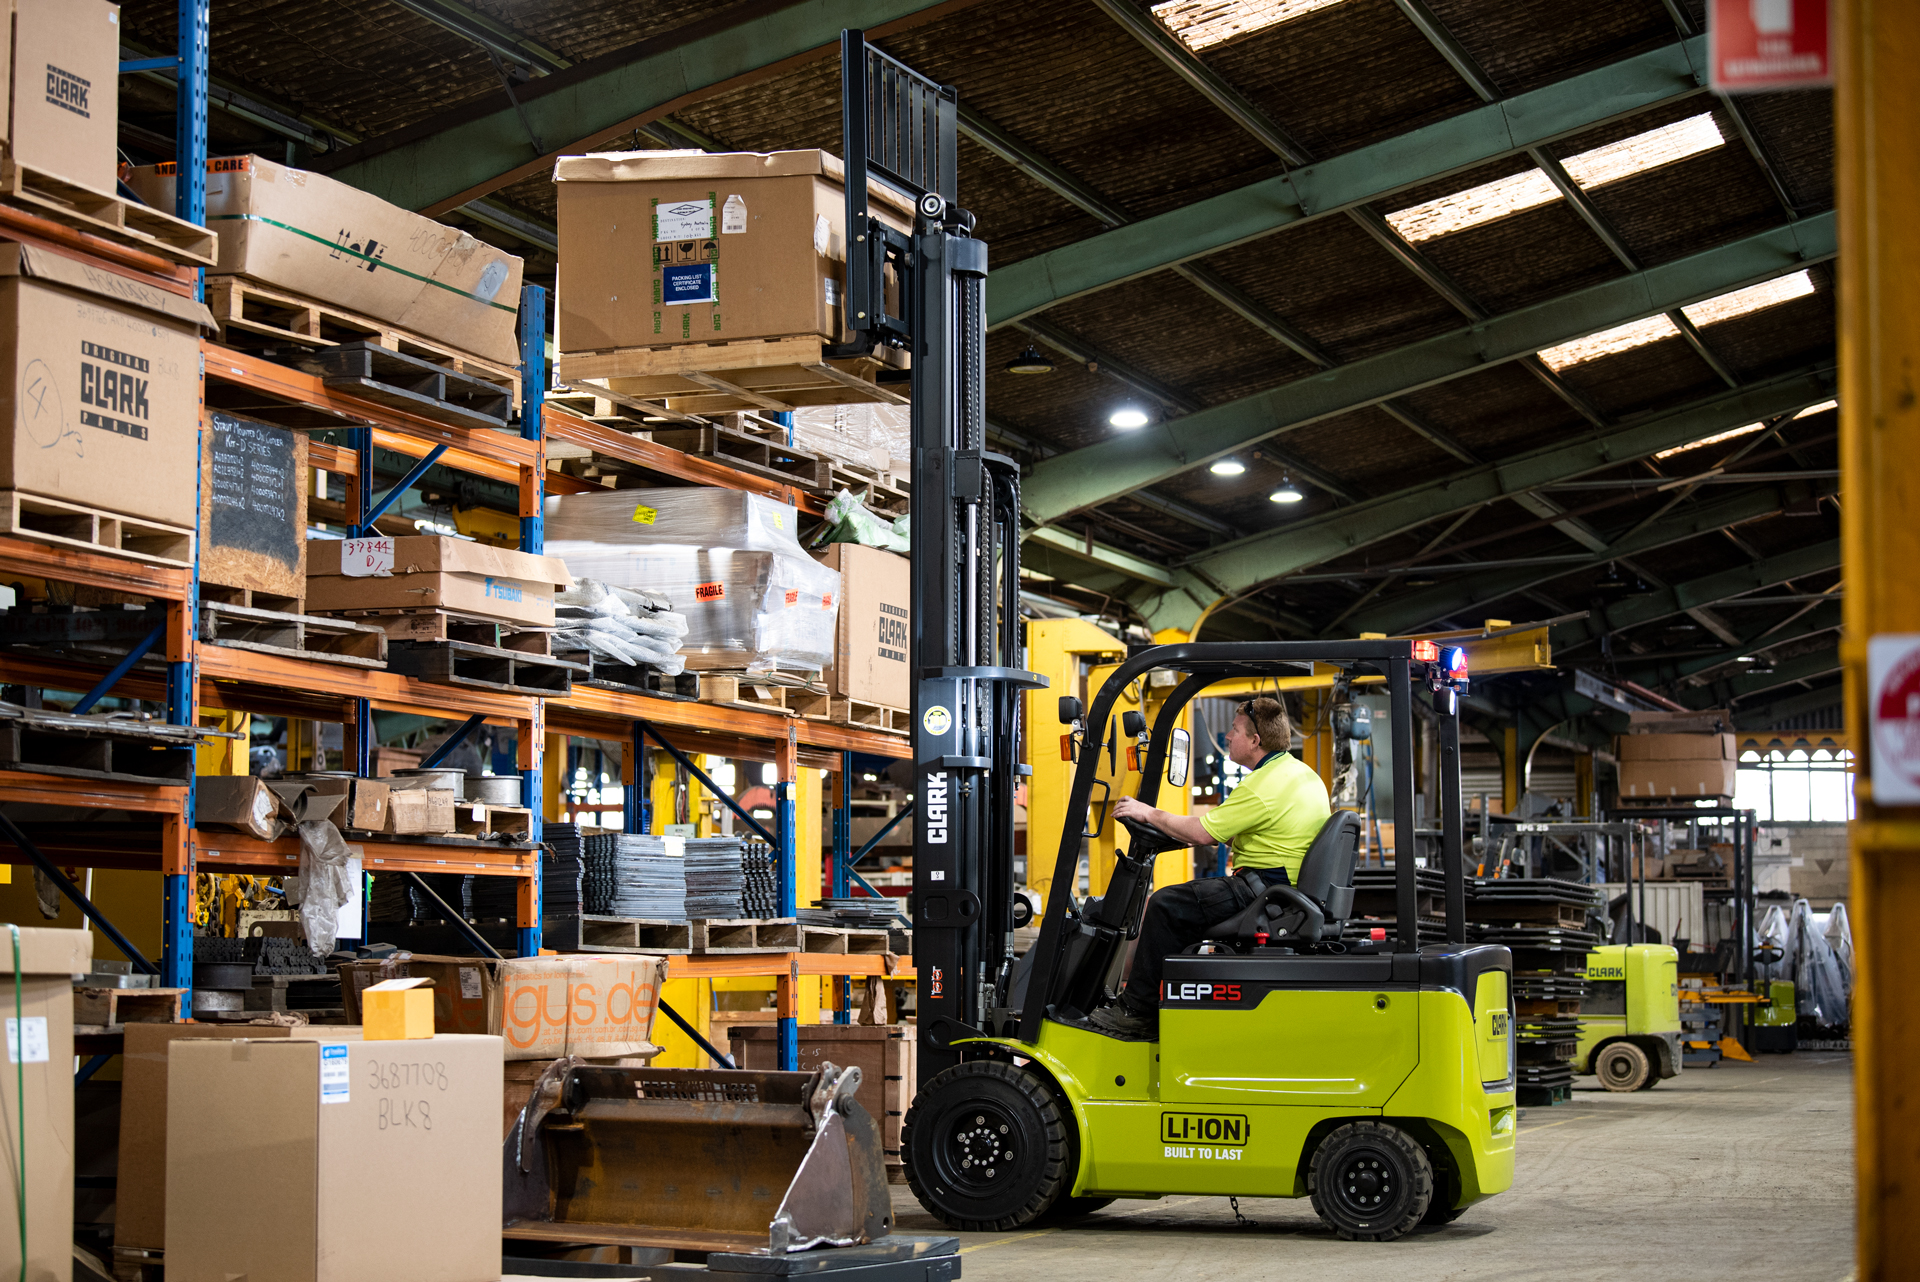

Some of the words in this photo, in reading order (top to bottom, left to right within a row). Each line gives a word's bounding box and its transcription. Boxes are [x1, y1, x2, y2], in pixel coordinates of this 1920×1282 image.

[46, 71, 88, 110] CLARK
[214, 159, 244, 172] CARE
[651, 214, 660, 240] CLARK
[709, 216, 718, 241] CLARK
[653, 279, 661, 304] CLARK
[676, 284, 700, 292] ENCLOSED
[682, 312, 690, 338] CLARK
[84, 342, 148, 372] ORIGINAL
[81, 362, 149, 420] CLARK
[82, 411, 147, 440] PARTS
[348, 540, 392, 556] 37844
[493, 584, 522, 603] TSUBAKI
[696, 584, 723, 598] FRAGILE
[879, 616, 908, 650] CLARK
[928, 772, 948, 844] CLARK
[1516, 824, 1534, 832] EPG
[1536, 824, 1549, 832] 25
[514, 972, 542, 982] plastics
[544, 972, 553, 980] for
[1588, 967, 1623, 978] CLARK
[1167, 982, 1242, 1000] LEP25
[367, 1059, 448, 1091] 3687708
[1168, 1116, 1240, 1140] LI-ION
[1164, 1146, 1196, 1158] BUILT
[1198, 1148, 1212, 1160] TO
[1215, 1148, 1242, 1160] LAST
